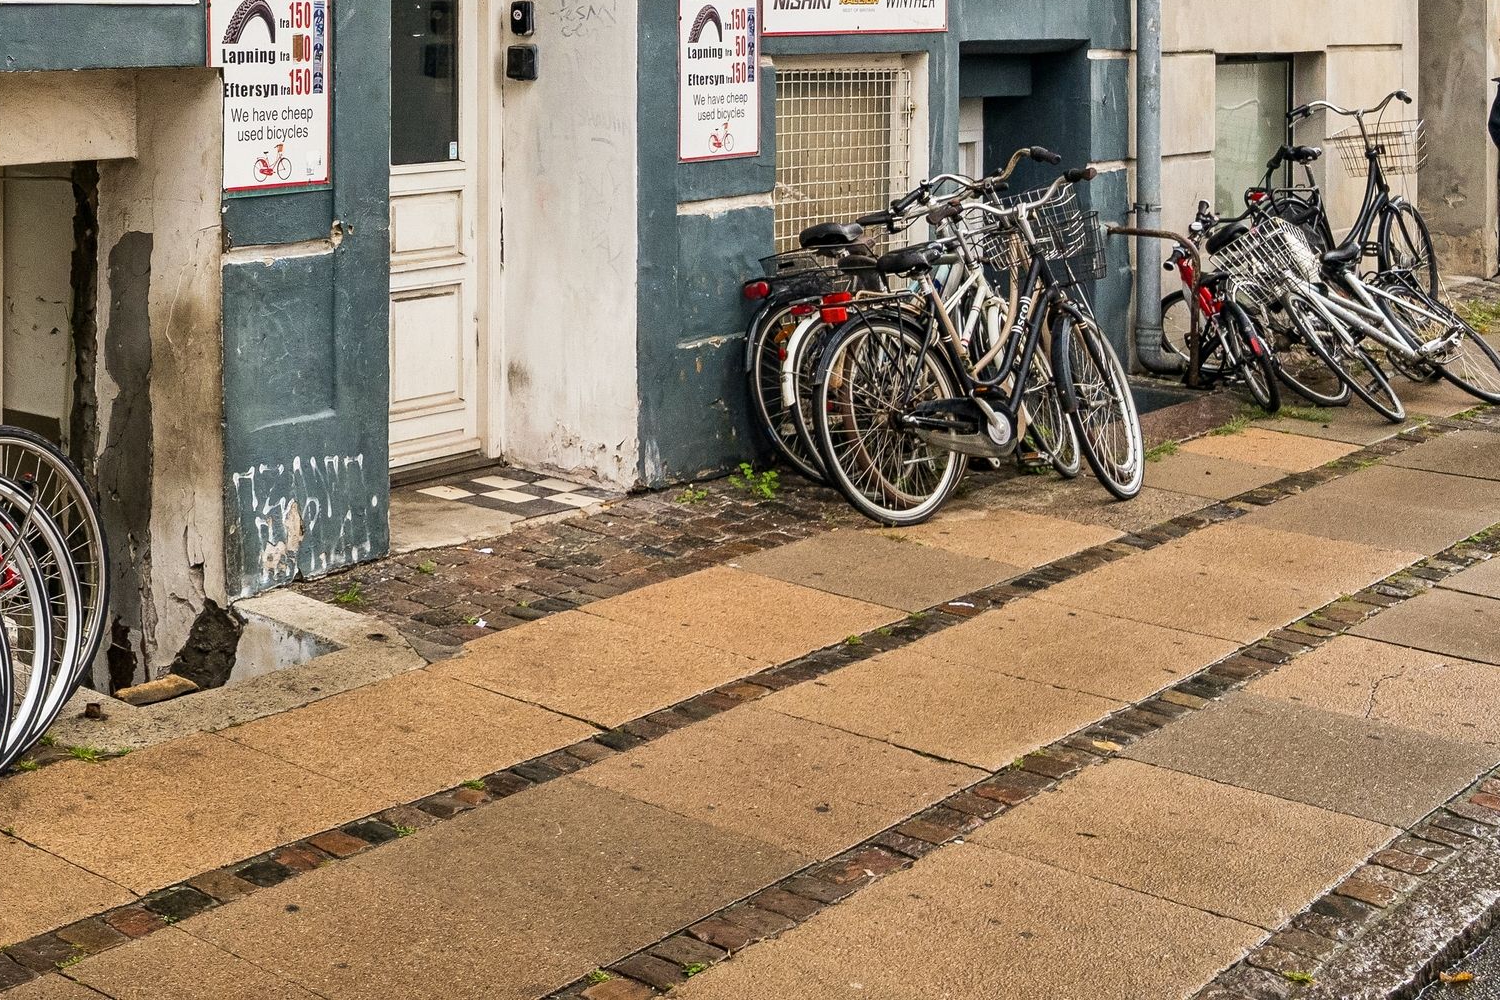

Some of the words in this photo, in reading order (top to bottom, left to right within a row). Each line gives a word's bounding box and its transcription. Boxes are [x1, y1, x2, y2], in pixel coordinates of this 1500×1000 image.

[279, 18, 289, 29] fra
[289, 1, 311, 29] 150
[731, 8, 745, 30] 150
[222, 48, 276, 64] Lapning
[280, 51, 290, 61] fra
[293, 35, 311, 62] 0
[688, 47, 722, 60] Lapning
[735, 36, 746, 57] 50
[223, 83, 278, 98] Eftersyn
[280, 85, 290, 95] fra
[289, 68, 311, 95] 150
[688, 74, 725, 86] Eftersyn
[732, 62, 746, 84] 150
[693, 94, 705, 106] We
[707, 94, 724, 105] have
[231, 108, 249, 122] We
[253, 107, 278, 122] have
[698, 109, 714, 121] used
[716, 107, 745, 122] bicycles
[237, 127, 263, 142] used
[267, 125, 309, 142] bicycles
